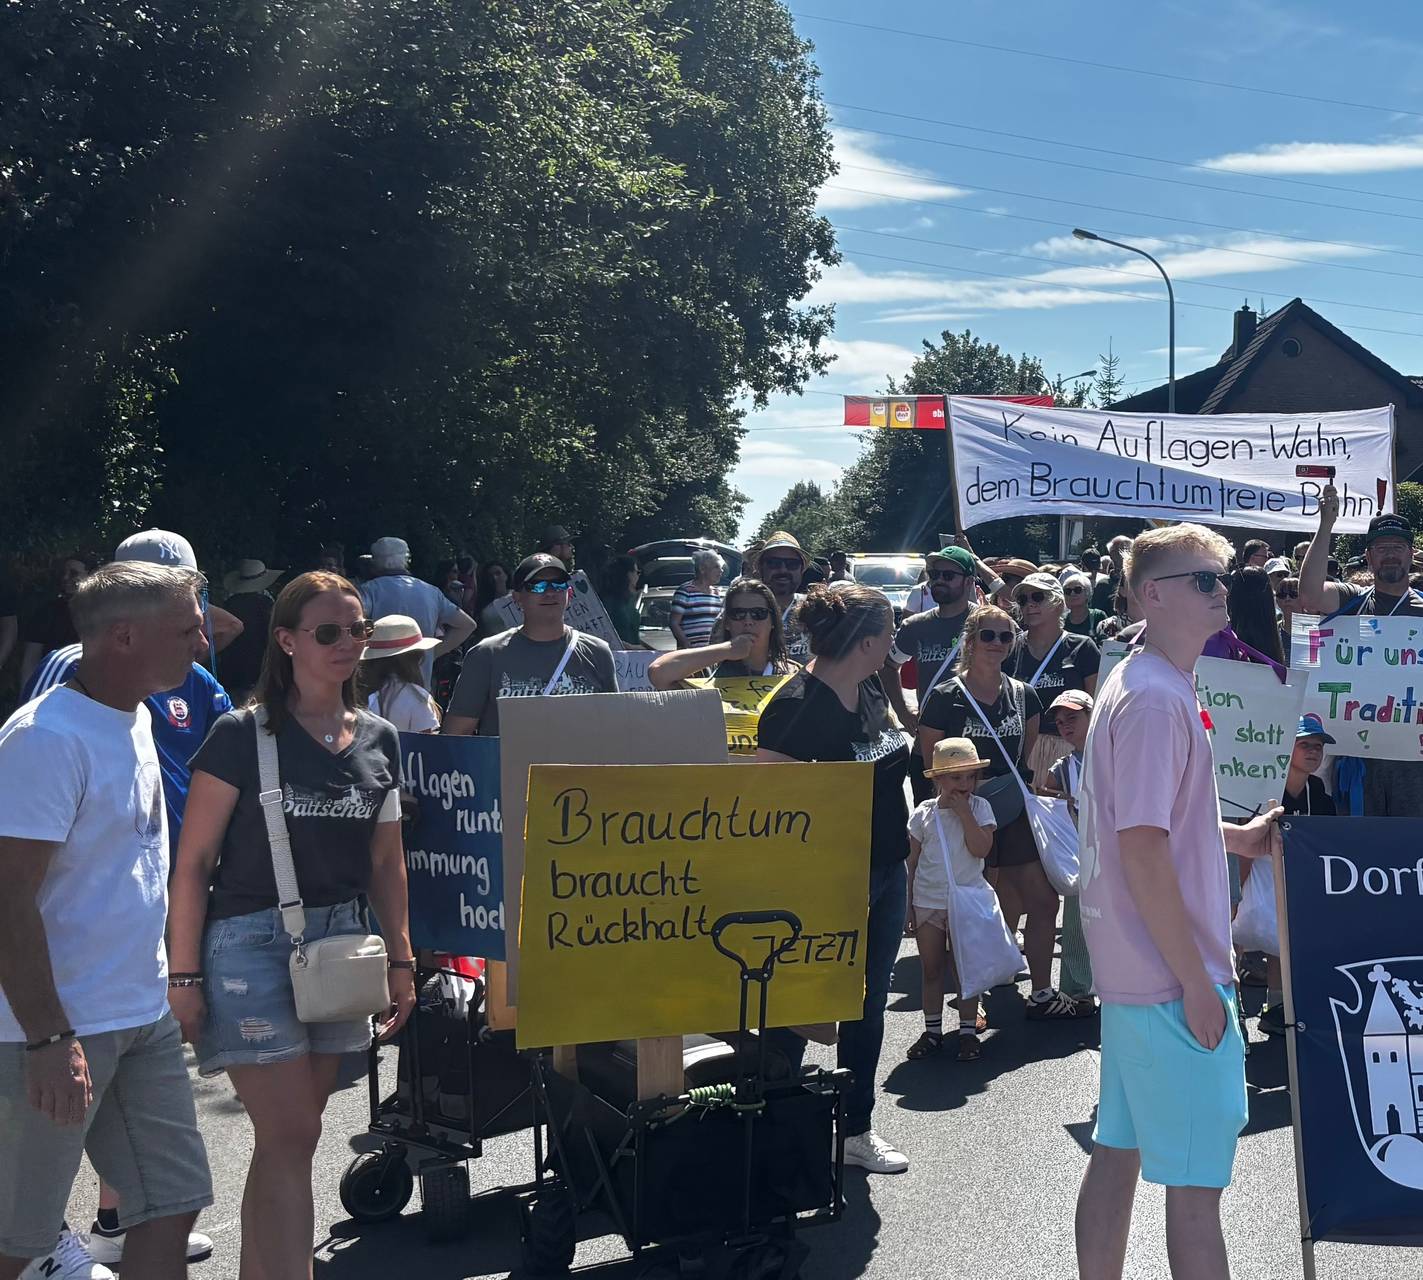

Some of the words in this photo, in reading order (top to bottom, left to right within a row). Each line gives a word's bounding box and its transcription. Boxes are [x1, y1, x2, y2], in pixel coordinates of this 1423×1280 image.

[1096, 420, 1351, 467] Auflagen-Wahn,
[966, 465, 1020, 506] dem
[1030, 462, 1213, 508] Brauchtum
[1299, 478, 1387, 516] Bhn!
[159, 537, 182, 560] NY
[1309, 628, 1373, 666] Für
[1234, 720, 1285, 745] statt
[401, 752, 475, 811] flagen
[1216, 754, 1291, 780] nken!
[456, 798, 504, 834] runt
[547, 787, 811, 846] Brauchtum
[551, 859, 702, 899] braucht
[548, 905, 714, 950] Rückhalt
[752, 929, 860, 967] JETZT!
